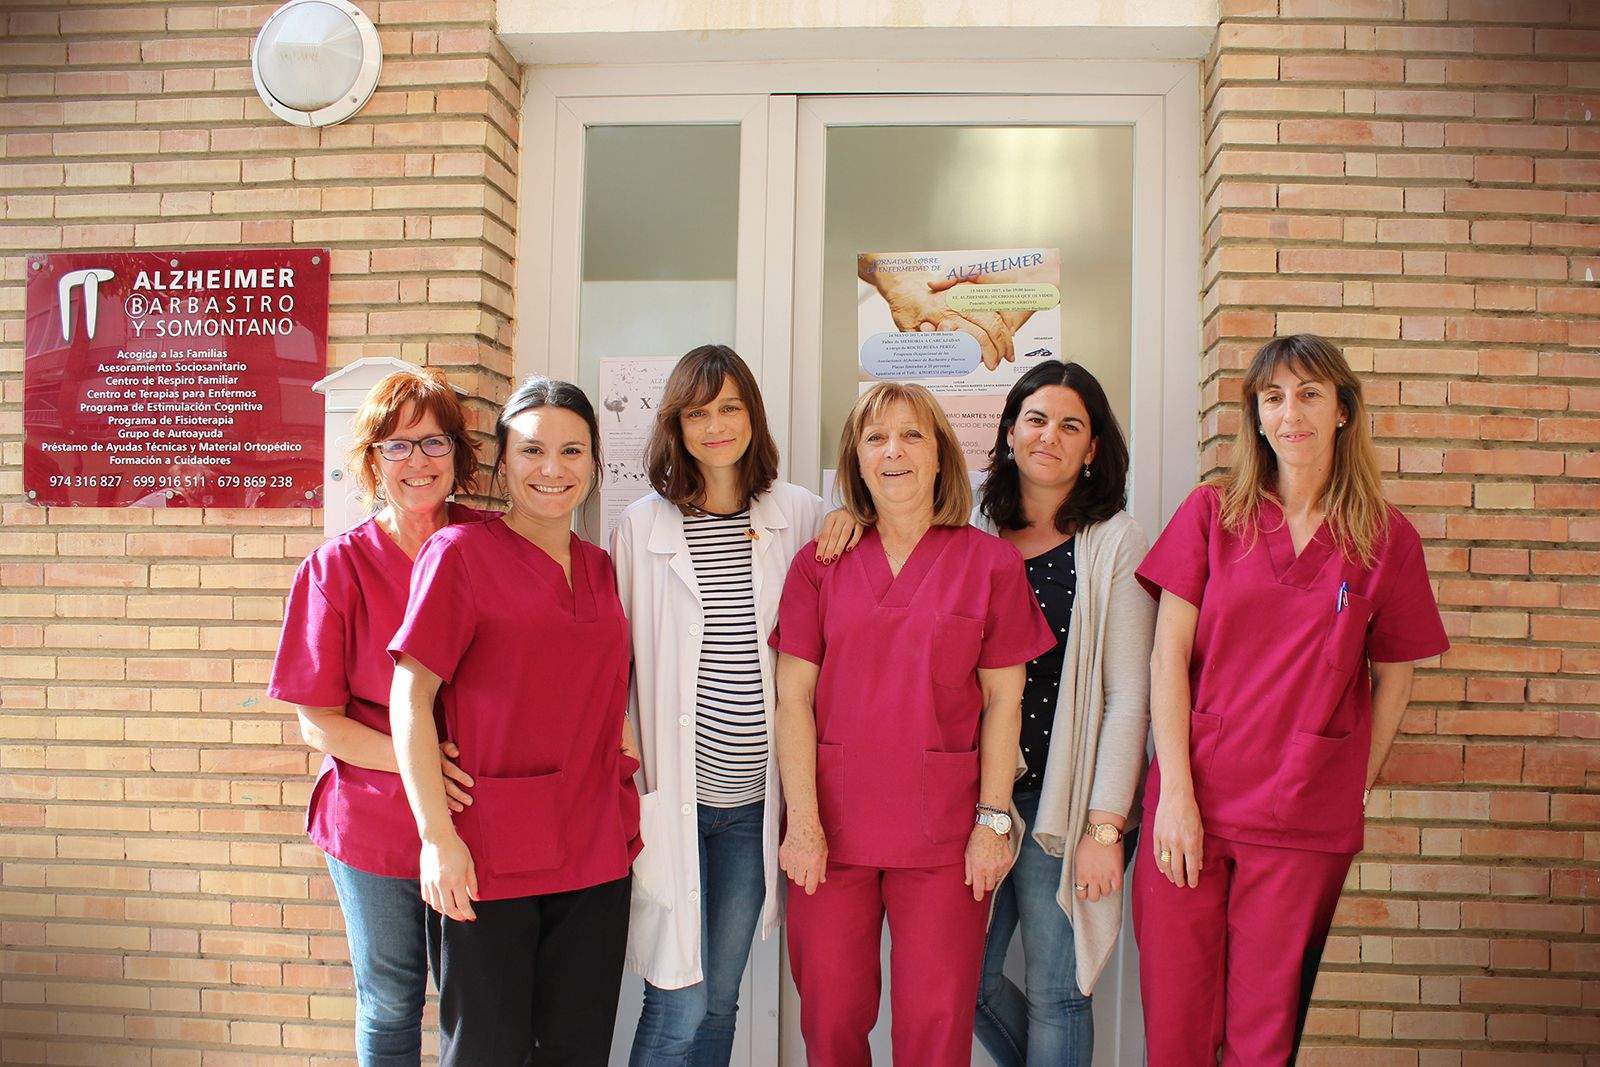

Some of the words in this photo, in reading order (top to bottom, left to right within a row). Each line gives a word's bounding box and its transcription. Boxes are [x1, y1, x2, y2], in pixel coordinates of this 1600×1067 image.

[946, 252, 1044, 281] ALZHEIMER
[133, 268, 294, 290] ALZHEIMER
[130, 295, 294, 316] BARBASTRO
[132, 320, 144, 337] Y
[156, 317, 293, 337] SOMONTANO
[116, 349, 158, 360] Acogida
[170, 349, 184, 360] las
[187, 348, 227, 360] Familias
[97, 362, 172, 372] Asesoramiento
[175, 360, 247, 371] Sociosanitario
[105, 376, 139, 385] Centro
[142, 376, 155, 385] de
[157, 375, 195, 388] Respiro
[198, 375, 239, 385] Familiar
[87, 389, 121, 399] Centro
[123, 389, 136, 398] de
[139, 389, 179, 400] Terapias
[182, 391, 206, 402] para
[208, 388, 257, 398] Enfermos
[80, 403, 129, 414] Programa
[132, 402, 144, 412] de
[147, 402, 211, 411] Estimulación
[214, 402, 263, 413] Cognitiva
[640, 397, 652, 409] X
[108, 416, 156, 427] Programa
[159, 415, 172, 425] de
[175, 415, 234, 426] Fisioterapia
[118, 429, 150, 441] Grupo
[152, 429, 165, 438] de
[167, 428, 223, 440] Autoayuda
[42, 442, 88, 452] Préstamo
[91, 442, 103, 452] de
[106, 442, 142, 454] Ayudas
[145, 442, 187, 451] Técnicas
[190, 444, 196, 453] y
[199, 442, 241, 451] Material
[244, 441, 302, 453] Ortopédico
[110, 455, 162, 465] Formación
[165, 457, 171, 465] a
[174, 455, 231, 466] Cuidadores
[50, 476, 72, 487] 974
[75, 476, 97, 487] 316
[100, 476, 122, 487] 827
[133, 476, 157, 488] 699
[159, 476, 183, 488] 916
[185, 476, 206, 488] 511
[217, 476, 240, 487] 679
[243, 476, 266, 487] 869
[270, 476, 293, 488] 238
